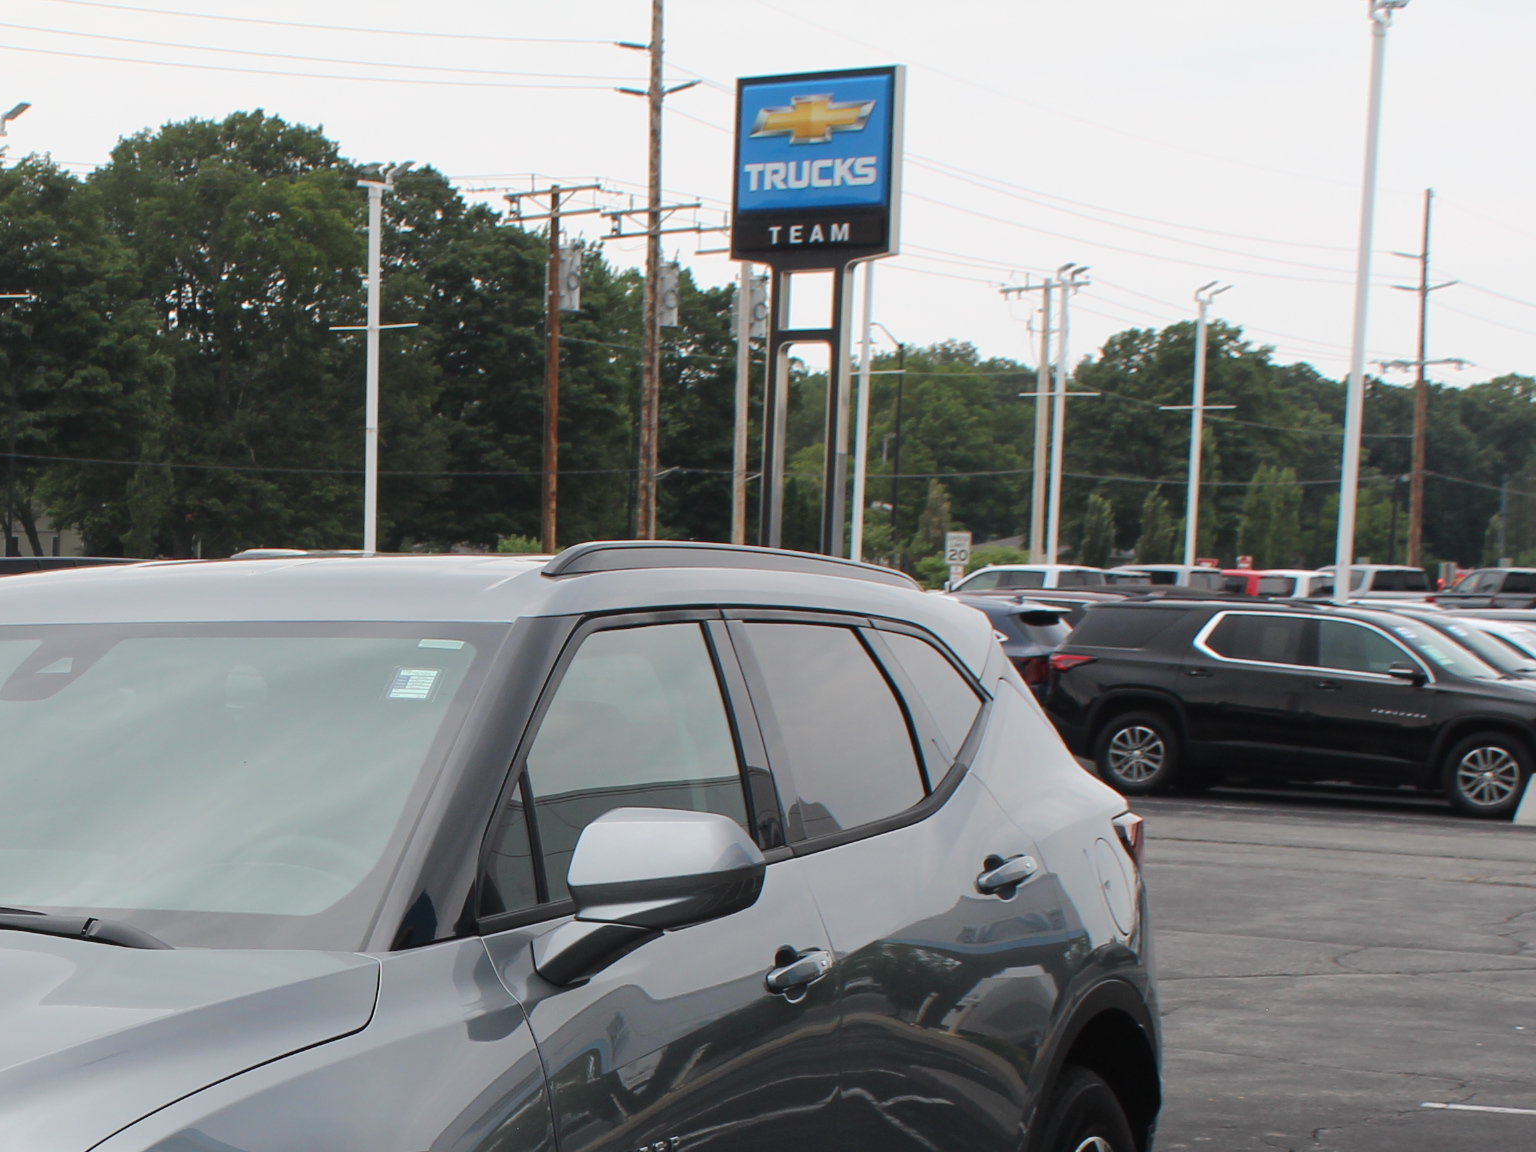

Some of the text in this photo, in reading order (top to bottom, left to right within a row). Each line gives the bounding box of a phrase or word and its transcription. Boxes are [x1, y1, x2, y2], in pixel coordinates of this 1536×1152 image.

[744, 156, 877, 192] TRUCKS
[768, 223, 850, 245] TEAM
[949, 549, 968, 561] 20
